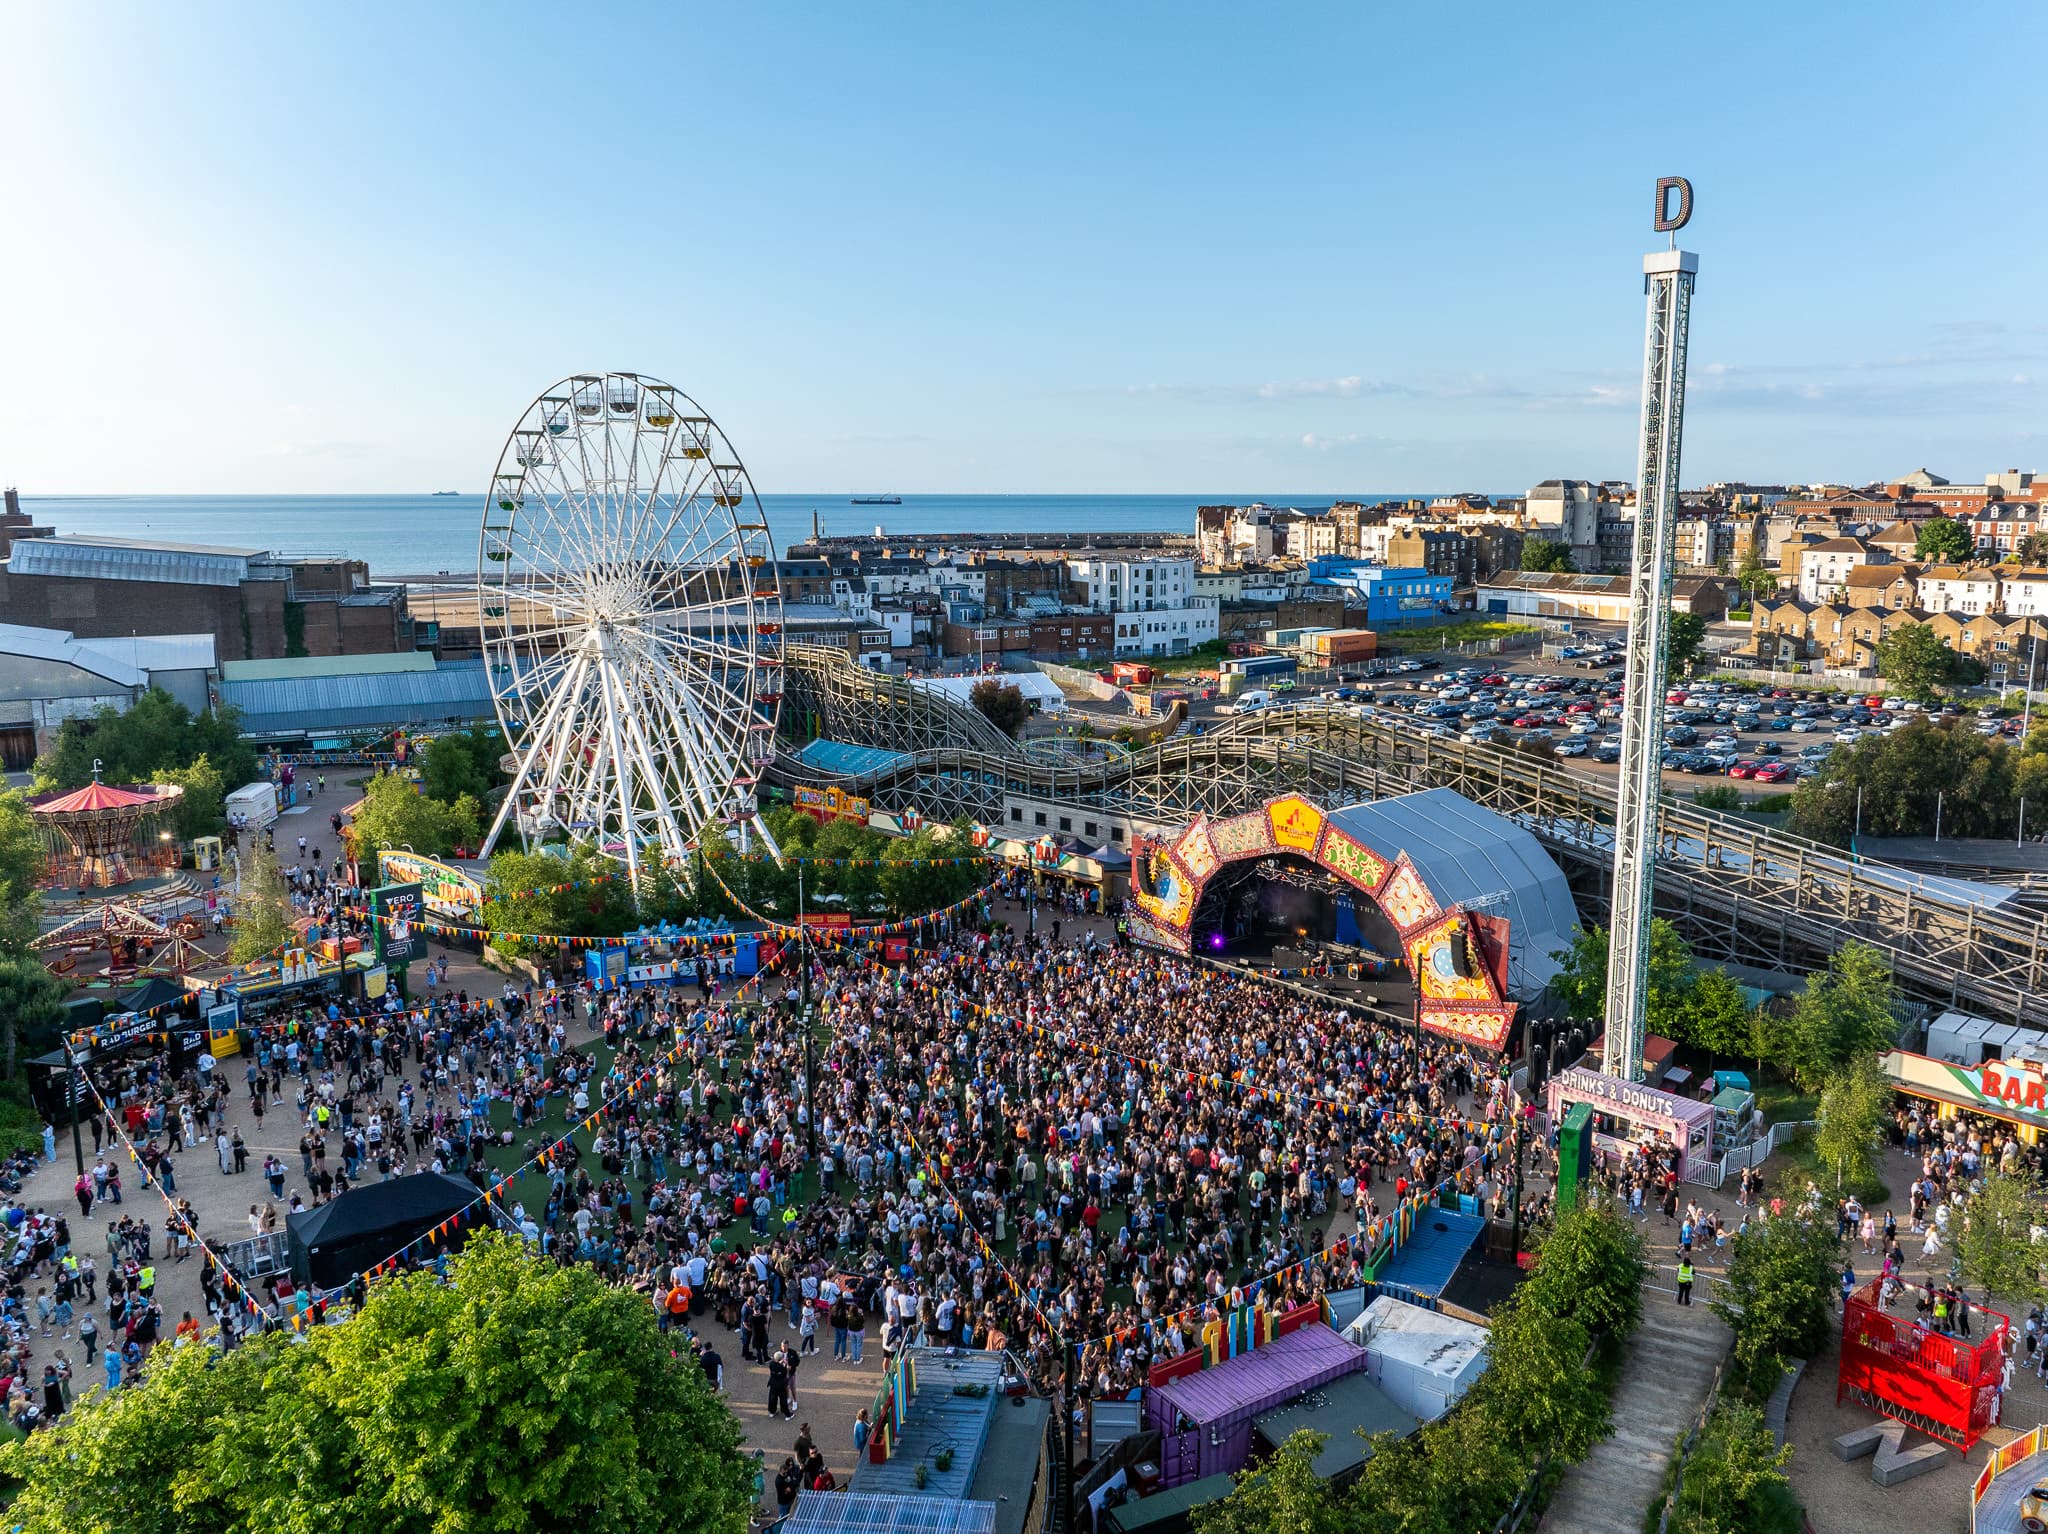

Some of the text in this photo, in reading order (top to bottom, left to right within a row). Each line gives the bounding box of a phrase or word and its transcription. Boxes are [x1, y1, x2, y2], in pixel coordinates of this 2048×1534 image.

[1654, 176, 1694, 232] D
[386, 861, 421, 883] GHOST
[438, 883, 474, 901] TRAIN
[1331, 898, 1355, 910] UNTIL
[1359, 905, 1375, 914] THE
[282, 961, 319, 985] BAR
[101, 1034, 120, 1048] RAD
[122, 1019, 158, 1039] BURGER
[1561, 1069, 1673, 1116] DRINKS & DONUTS
[1981, 1069, 2047, 1111] BAR
